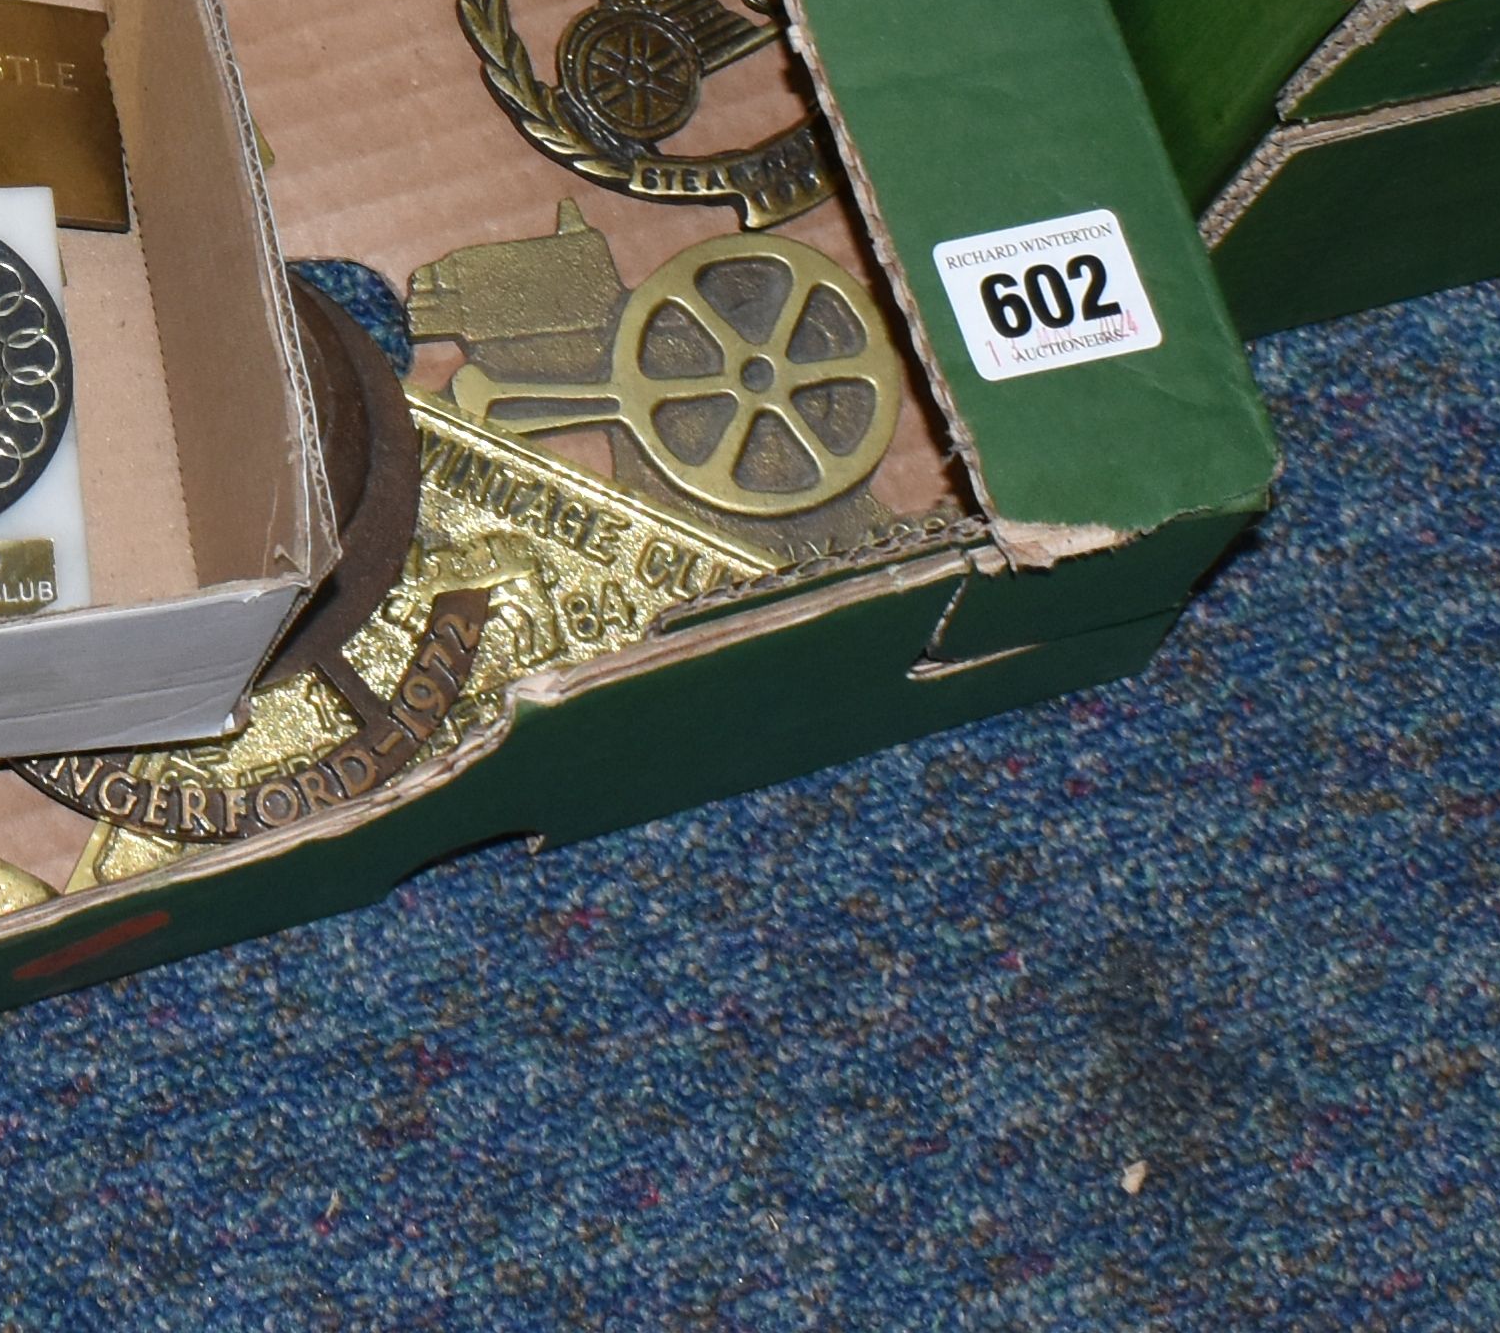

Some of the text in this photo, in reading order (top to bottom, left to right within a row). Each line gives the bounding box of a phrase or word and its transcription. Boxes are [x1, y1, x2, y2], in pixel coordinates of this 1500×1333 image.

[946, 222, 1113, 269] RICHARD WINTERTON
[980, 254, 1122, 338] 602
[1015, 329, 1125, 363] AUCTIONEERS
